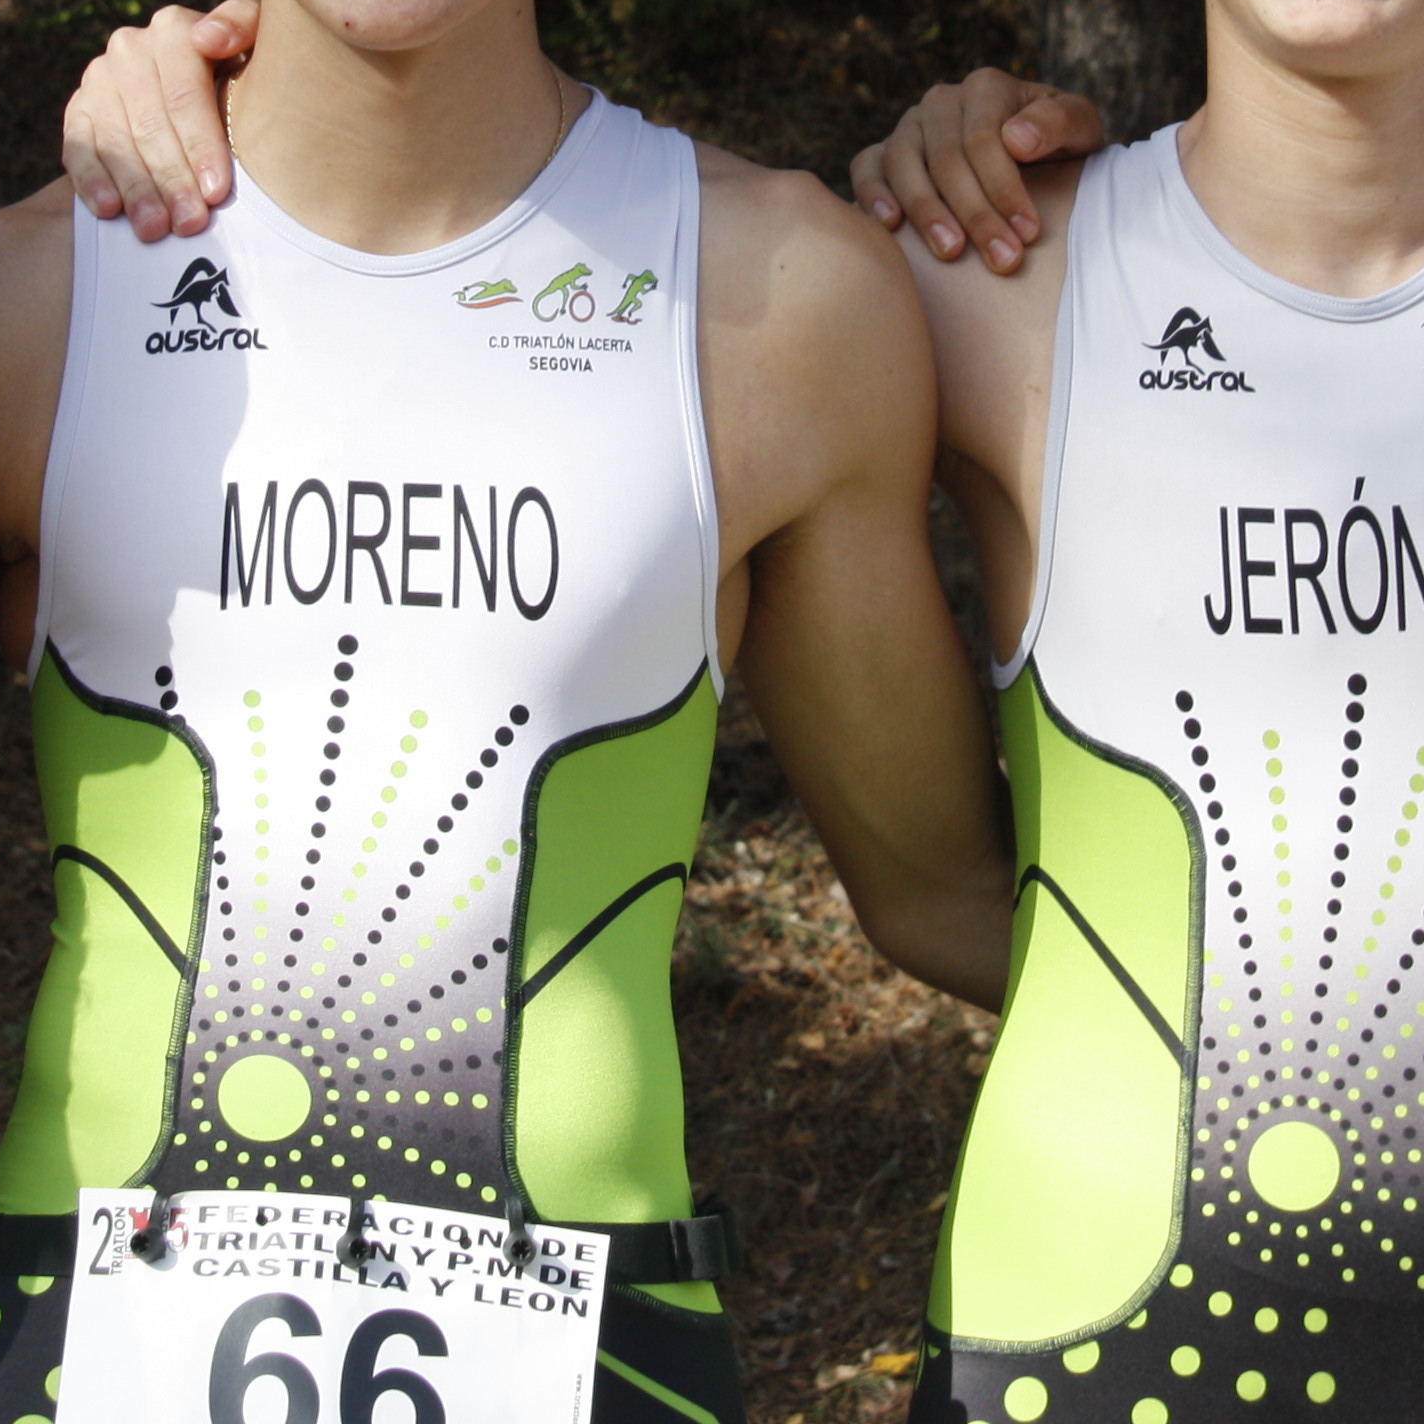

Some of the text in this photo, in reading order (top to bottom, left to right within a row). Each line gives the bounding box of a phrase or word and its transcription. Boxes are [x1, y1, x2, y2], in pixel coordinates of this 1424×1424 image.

[145, 328, 269, 355] austral
[489, 334, 633, 353] C.D TRIATLÓN LACERTA
[529, 356, 593, 373] SEGOVIA
[1139, 370, 1256, 393] austral
[218, 477, 560, 622] MORENO
[110, 1206, 126, 1276] TRIATLON
[193, 1232, 397, 1262] TRIATLN
[410, 1246, 436, 1266] Y
[538, 1264, 595, 1290] DE
[198, 1205, 503, 1249] FEDERACION
[541, 1238, 597, 1263] DE
[192, 1258, 588, 1317] CASTILLA Y LEON
[208, 1292, 449, 1424] 66
